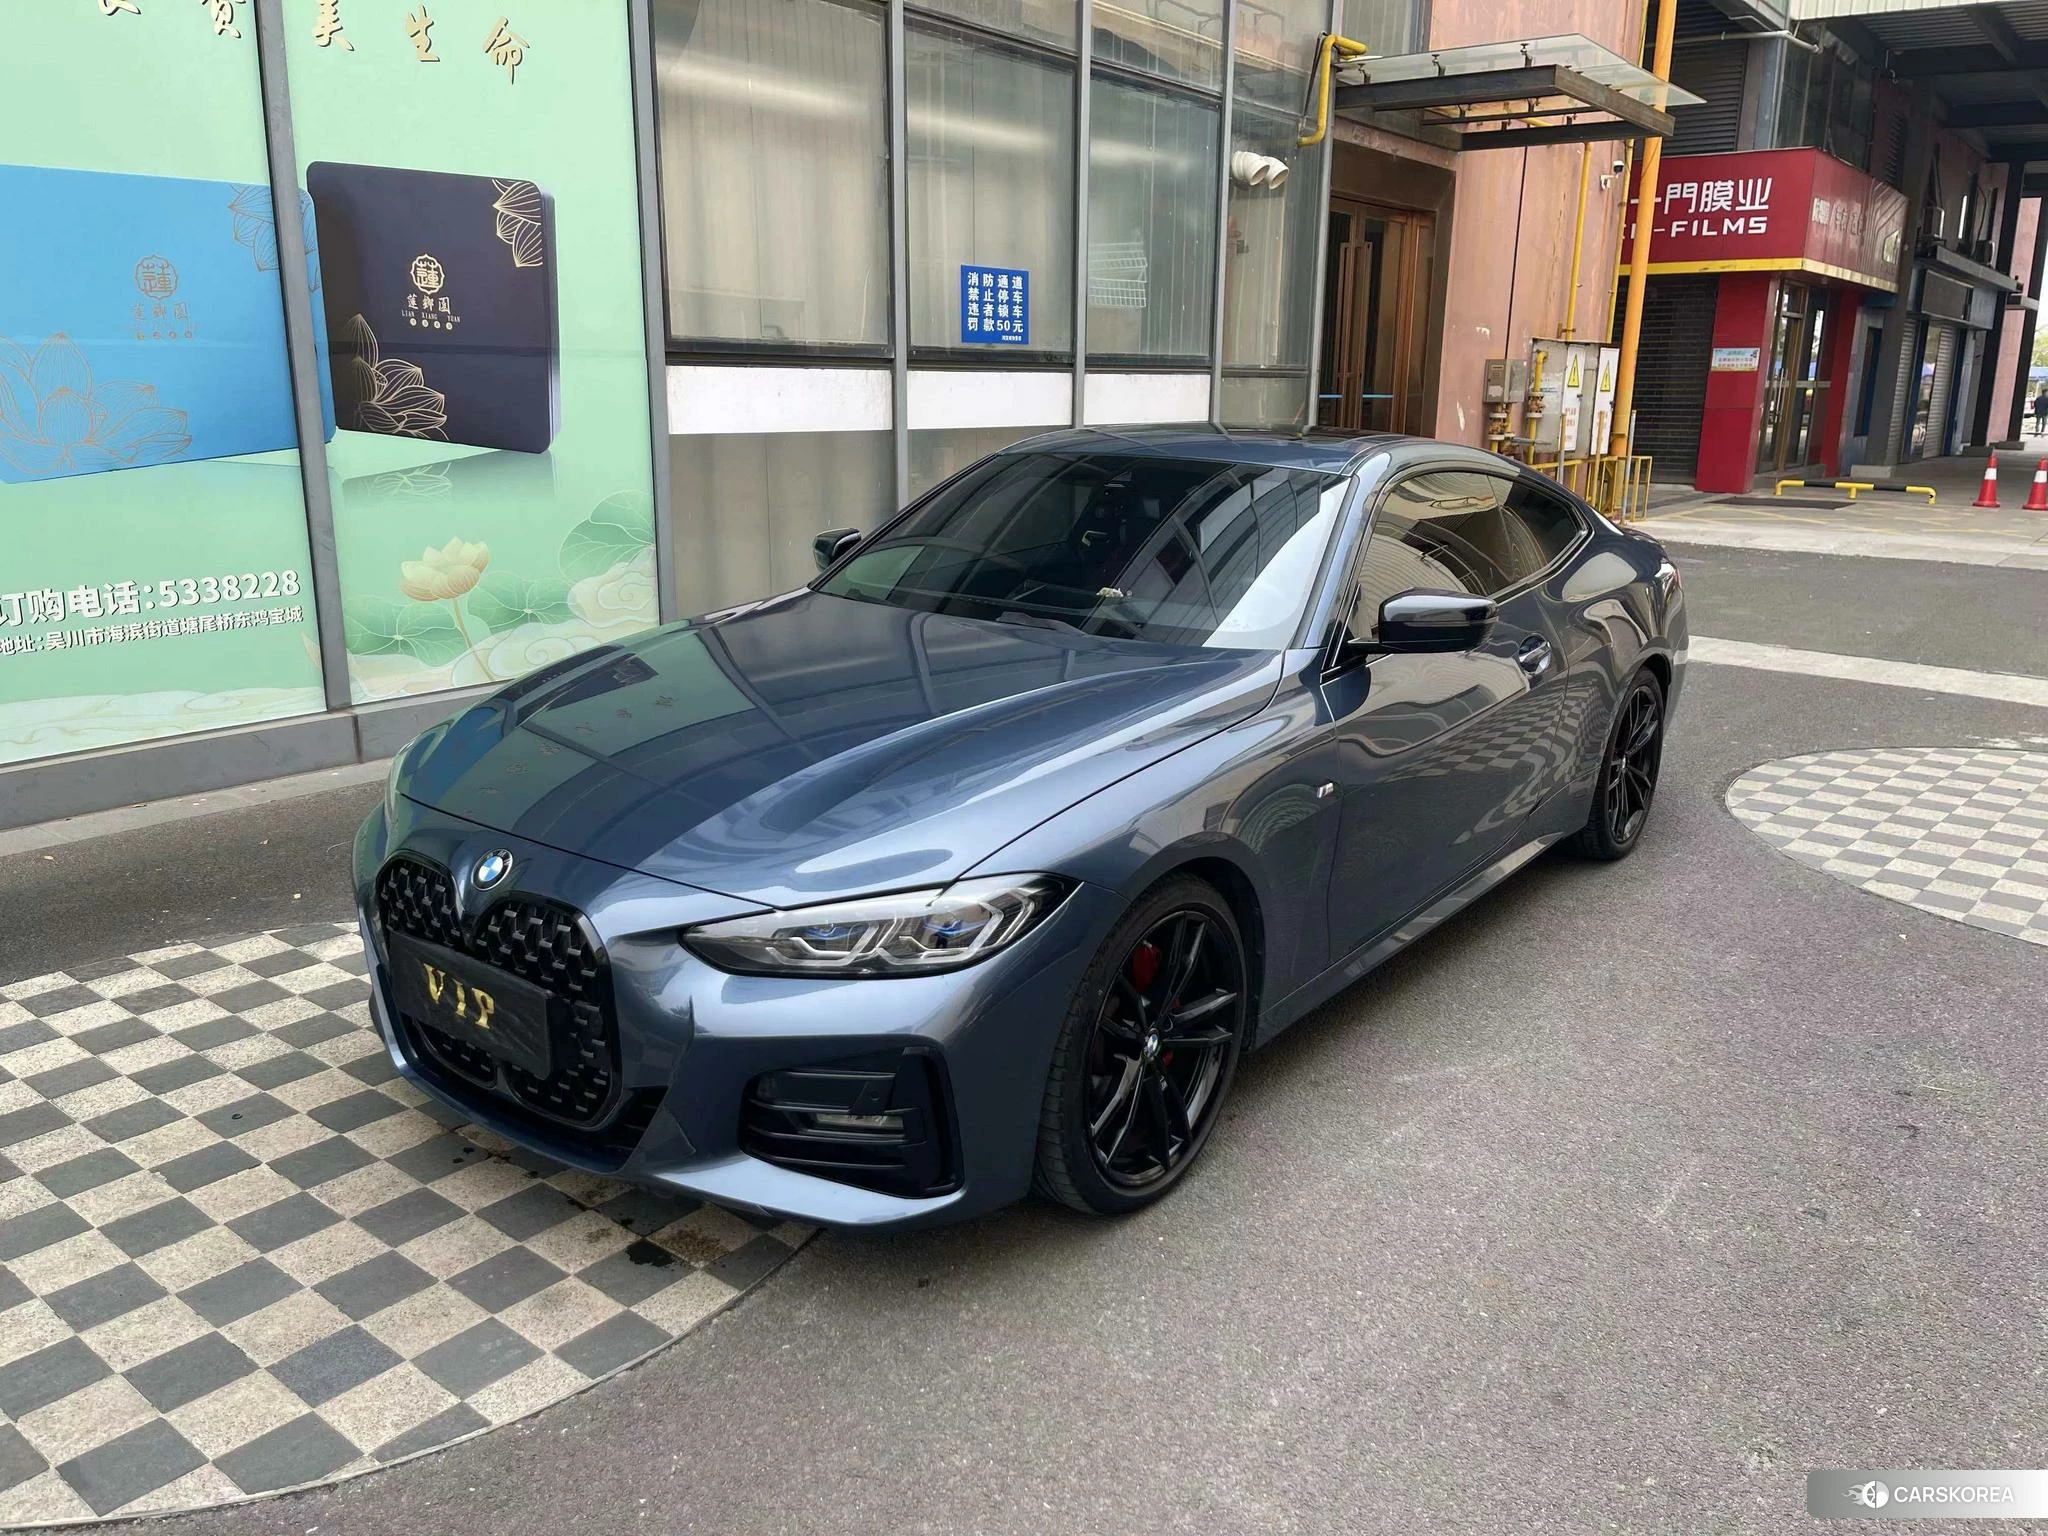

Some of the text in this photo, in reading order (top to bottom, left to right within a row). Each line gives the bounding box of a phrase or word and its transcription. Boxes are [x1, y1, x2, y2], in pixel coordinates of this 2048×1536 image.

[968, 271, 1023, 290] 消防通道
[968, 286, 1023, 304] 禁止停车
[968, 301, 1023, 319] 违者锁车
[968, 317, 1024, 333] 罚款50元
[423, 962, 496, 1030] VIP
